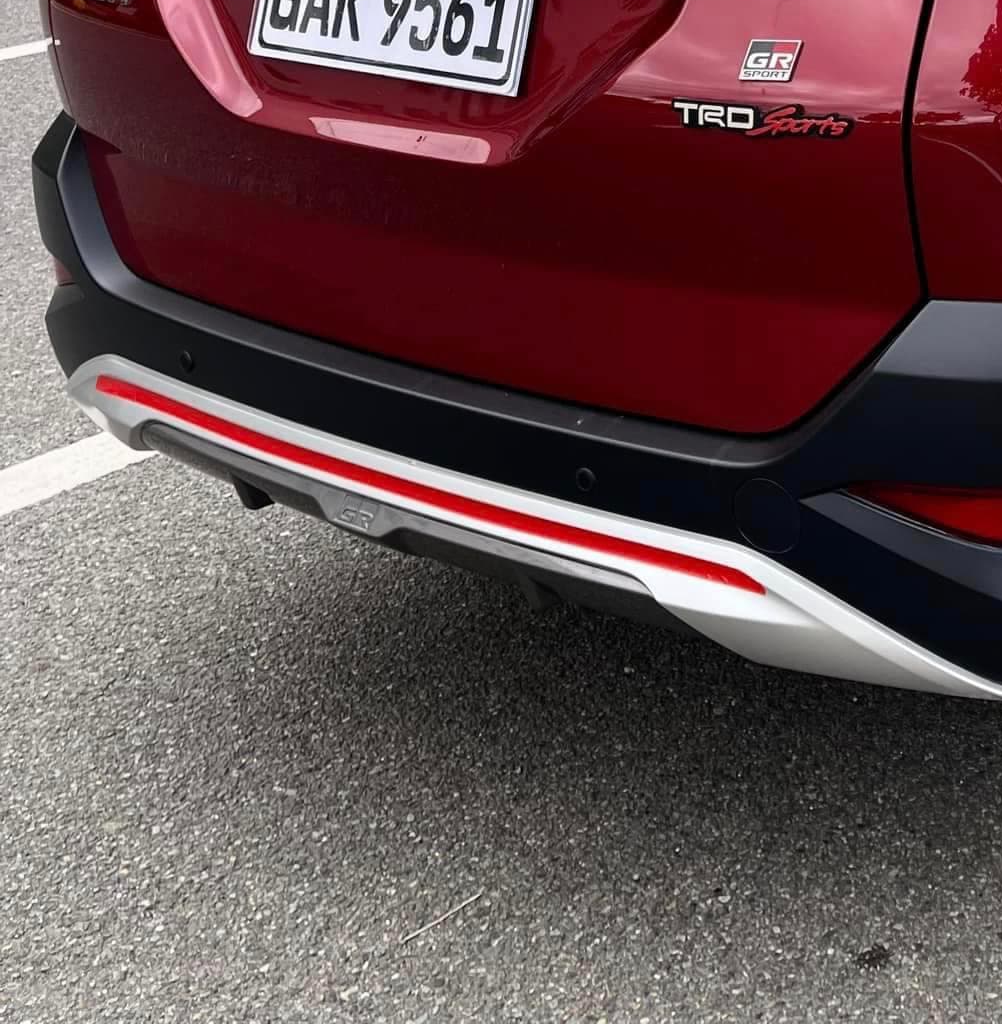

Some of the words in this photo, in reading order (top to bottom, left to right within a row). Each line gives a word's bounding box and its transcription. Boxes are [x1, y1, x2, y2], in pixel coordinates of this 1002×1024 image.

[746, 52, 794, 70] GR
[743, 70, 789, 78] SPORT
[674, 101, 755, 130] TRD
[746, 106, 849, 136] Sports
